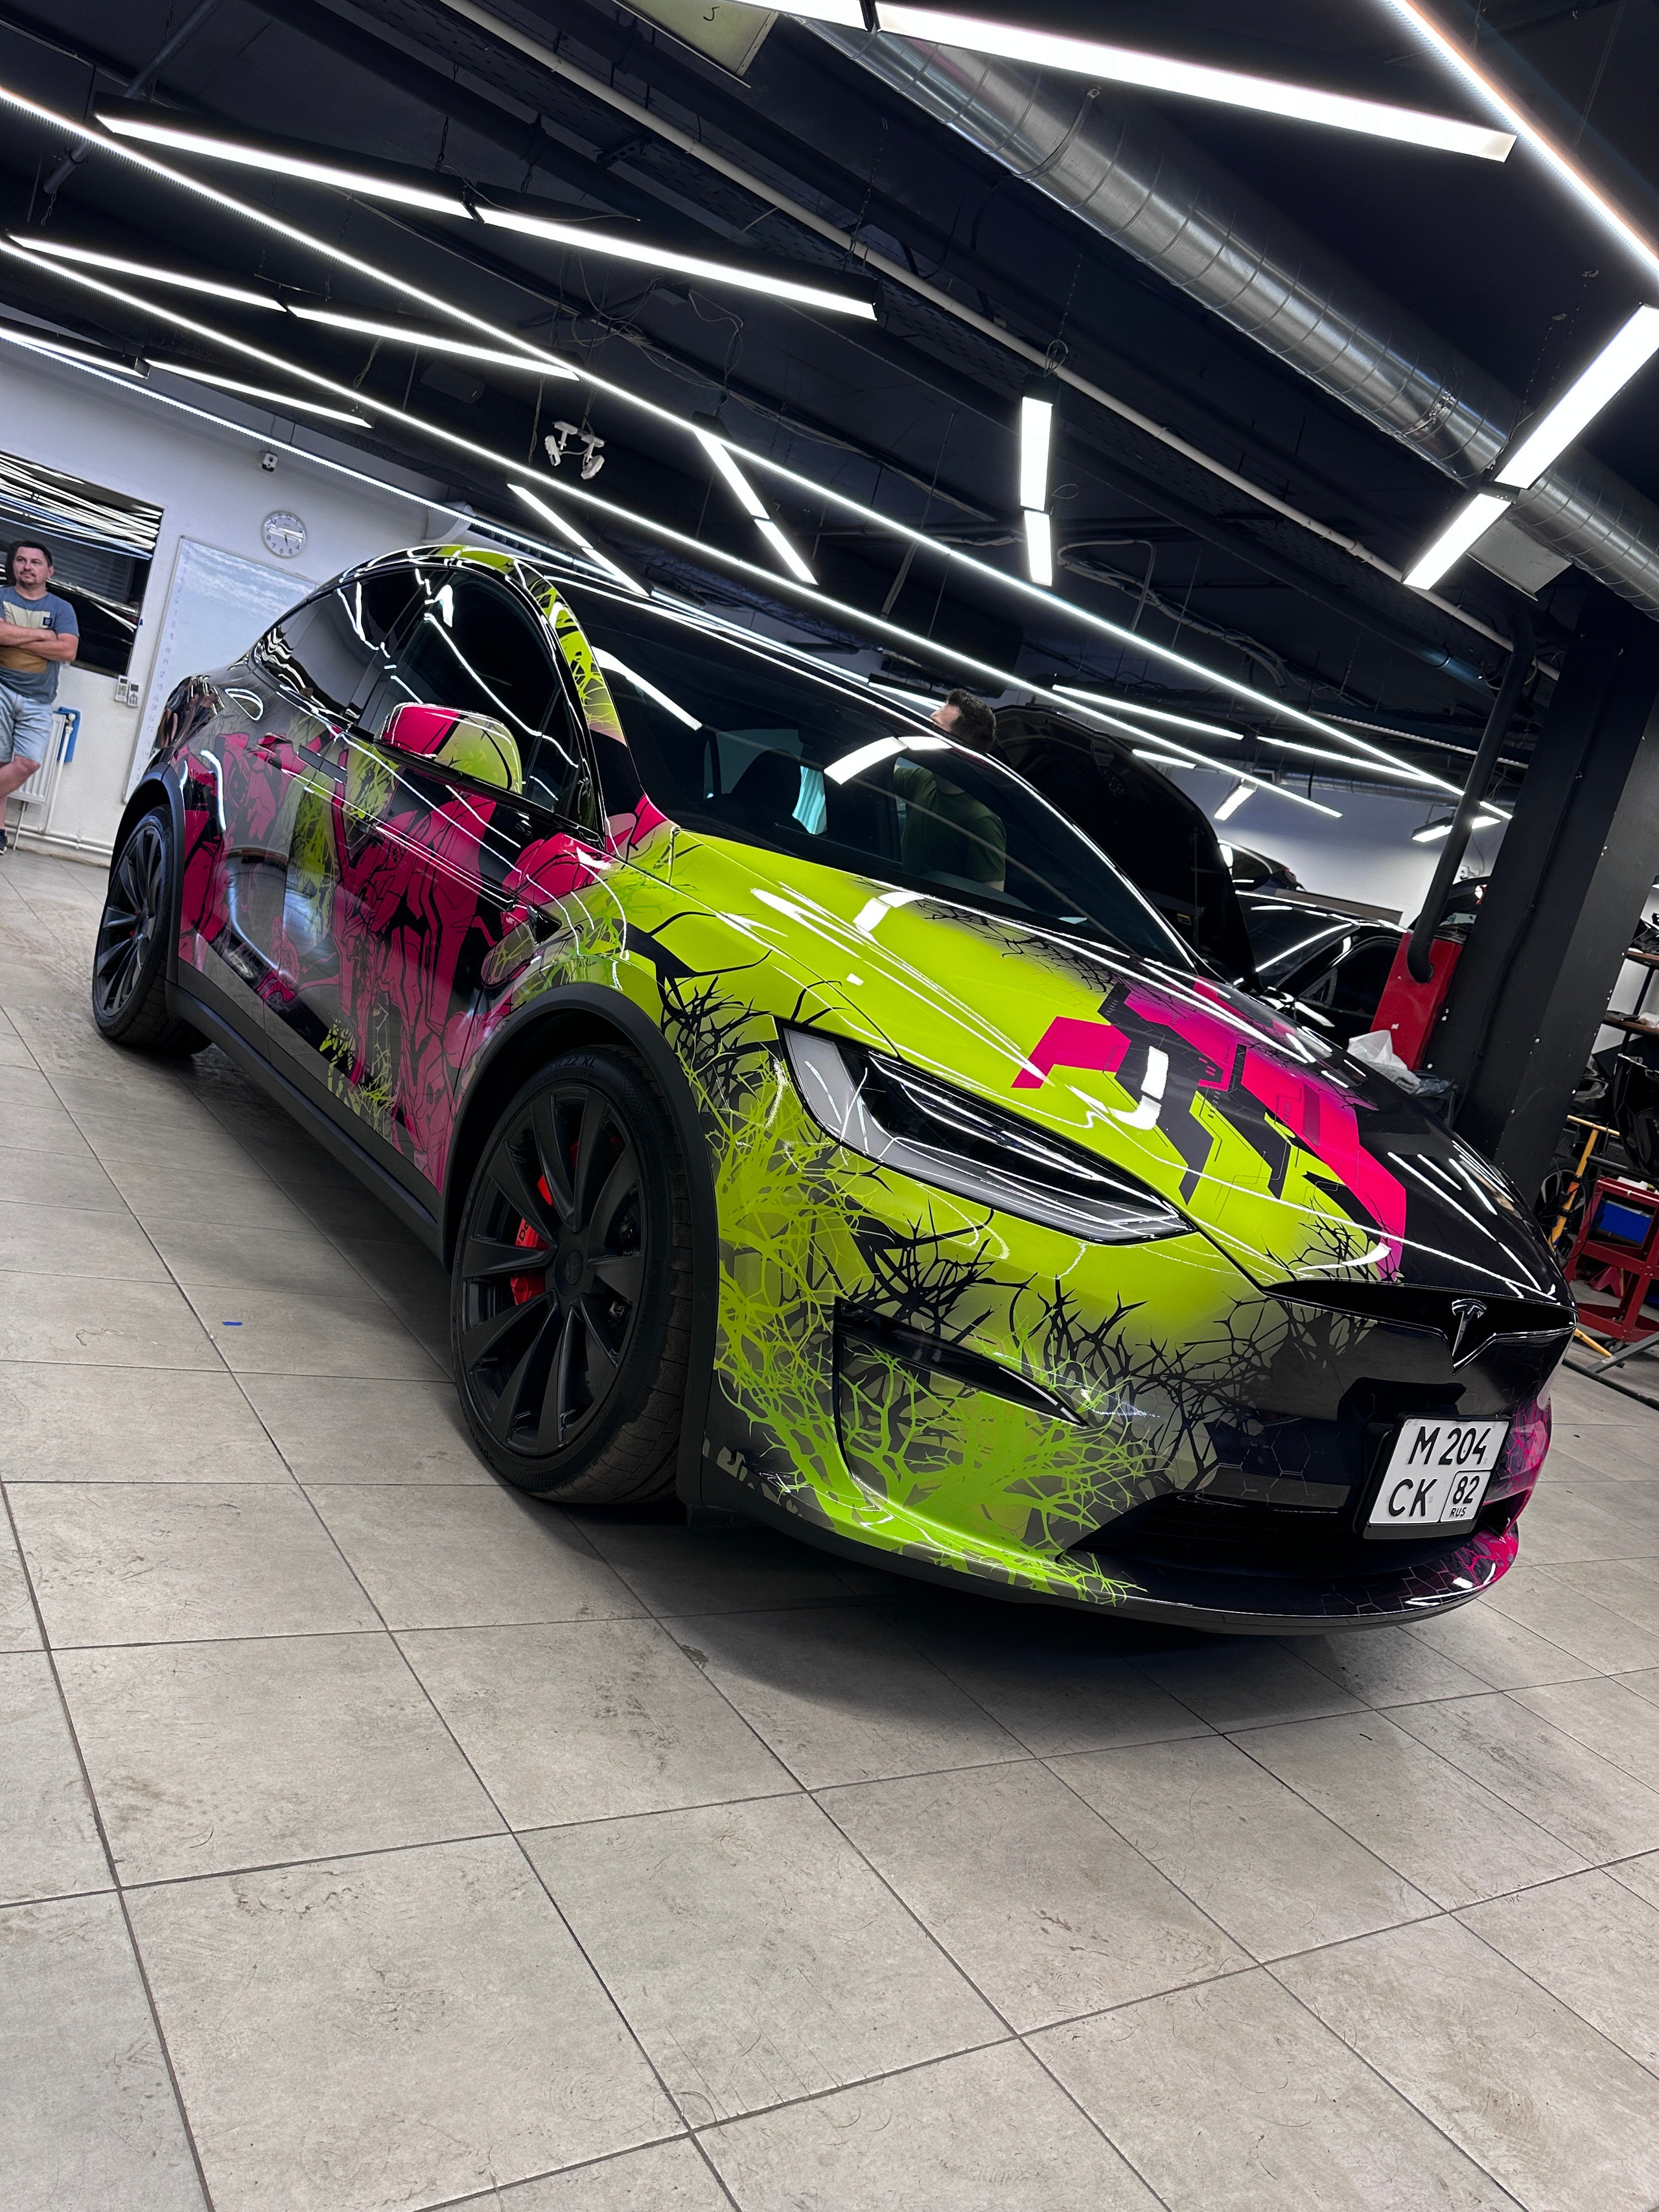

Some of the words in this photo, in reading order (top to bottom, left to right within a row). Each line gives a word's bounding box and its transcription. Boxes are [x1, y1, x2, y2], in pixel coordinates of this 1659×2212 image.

[581, 1056, 596, 1069] XL
[1408, 1426, 1441, 1465] M
[1438, 1427, 1492, 1465] 204
[1388, 1478, 1438, 1517] CK
[1452, 1475, 1480, 1504] 82
[1450, 1507, 1467, 1518] RUS
